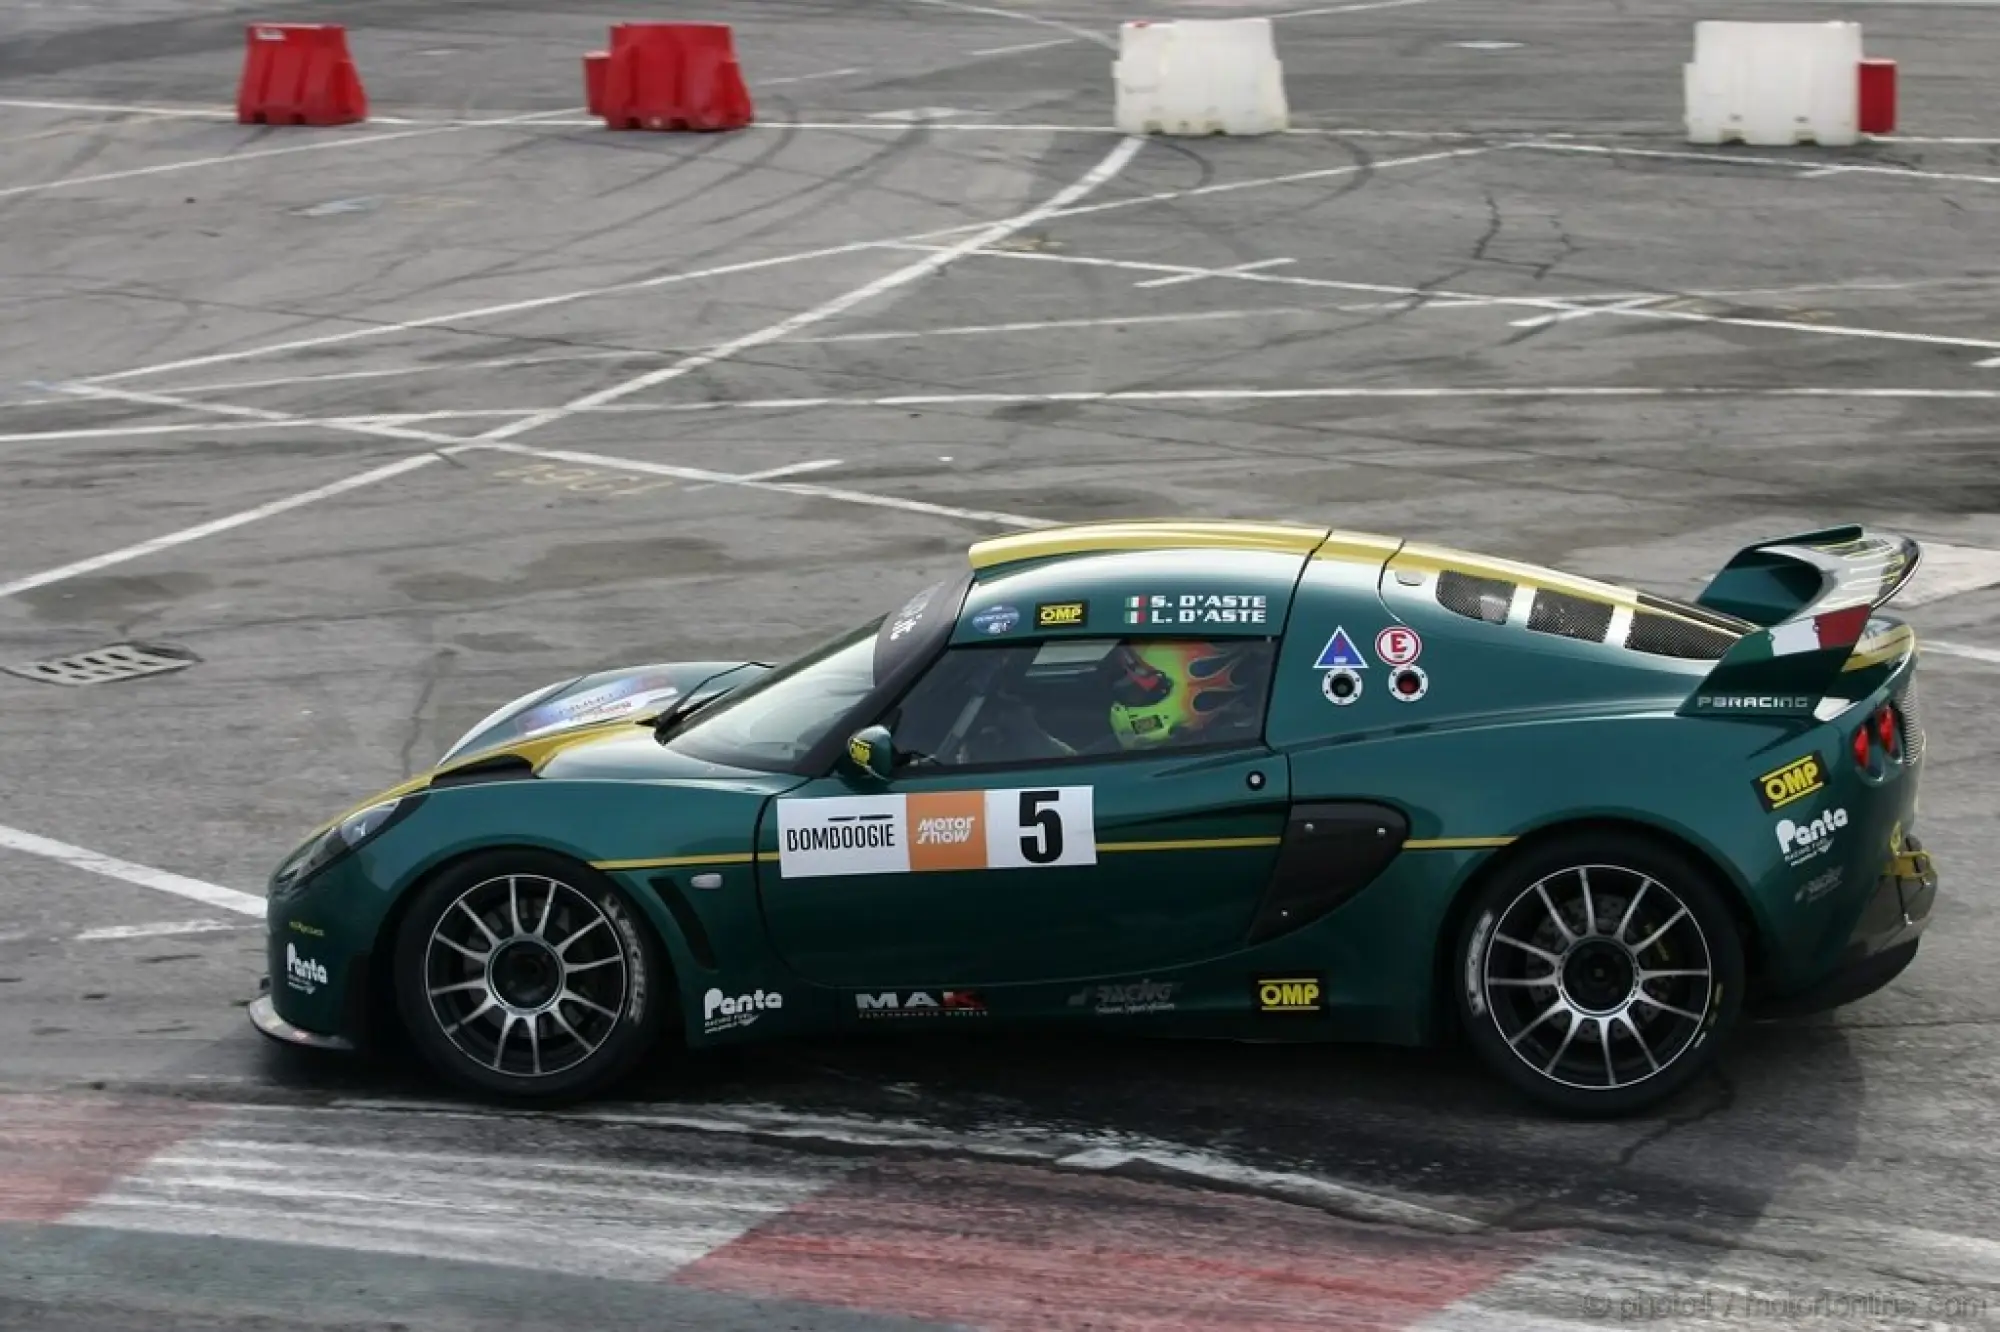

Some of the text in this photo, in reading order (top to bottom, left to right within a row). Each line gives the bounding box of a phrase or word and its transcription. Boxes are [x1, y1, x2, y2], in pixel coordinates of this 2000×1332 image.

[1041, 605, 1082, 622] OMP
[1151, 595, 1266, 608] S. D'ASTE
[1151, 609, 1266, 623] L. D'ASTE
[1390, 633, 1407, 653] E
[1764, 760, 1819, 801] OMP
[786, 823, 895, 852] BOMBOOGIE
[1018, 790, 1064, 864] 5
[1775, 807, 1849, 854] Panta
[704, 987, 783, 1020] Panta
[1260, 982, 1320, 1006] OMP
